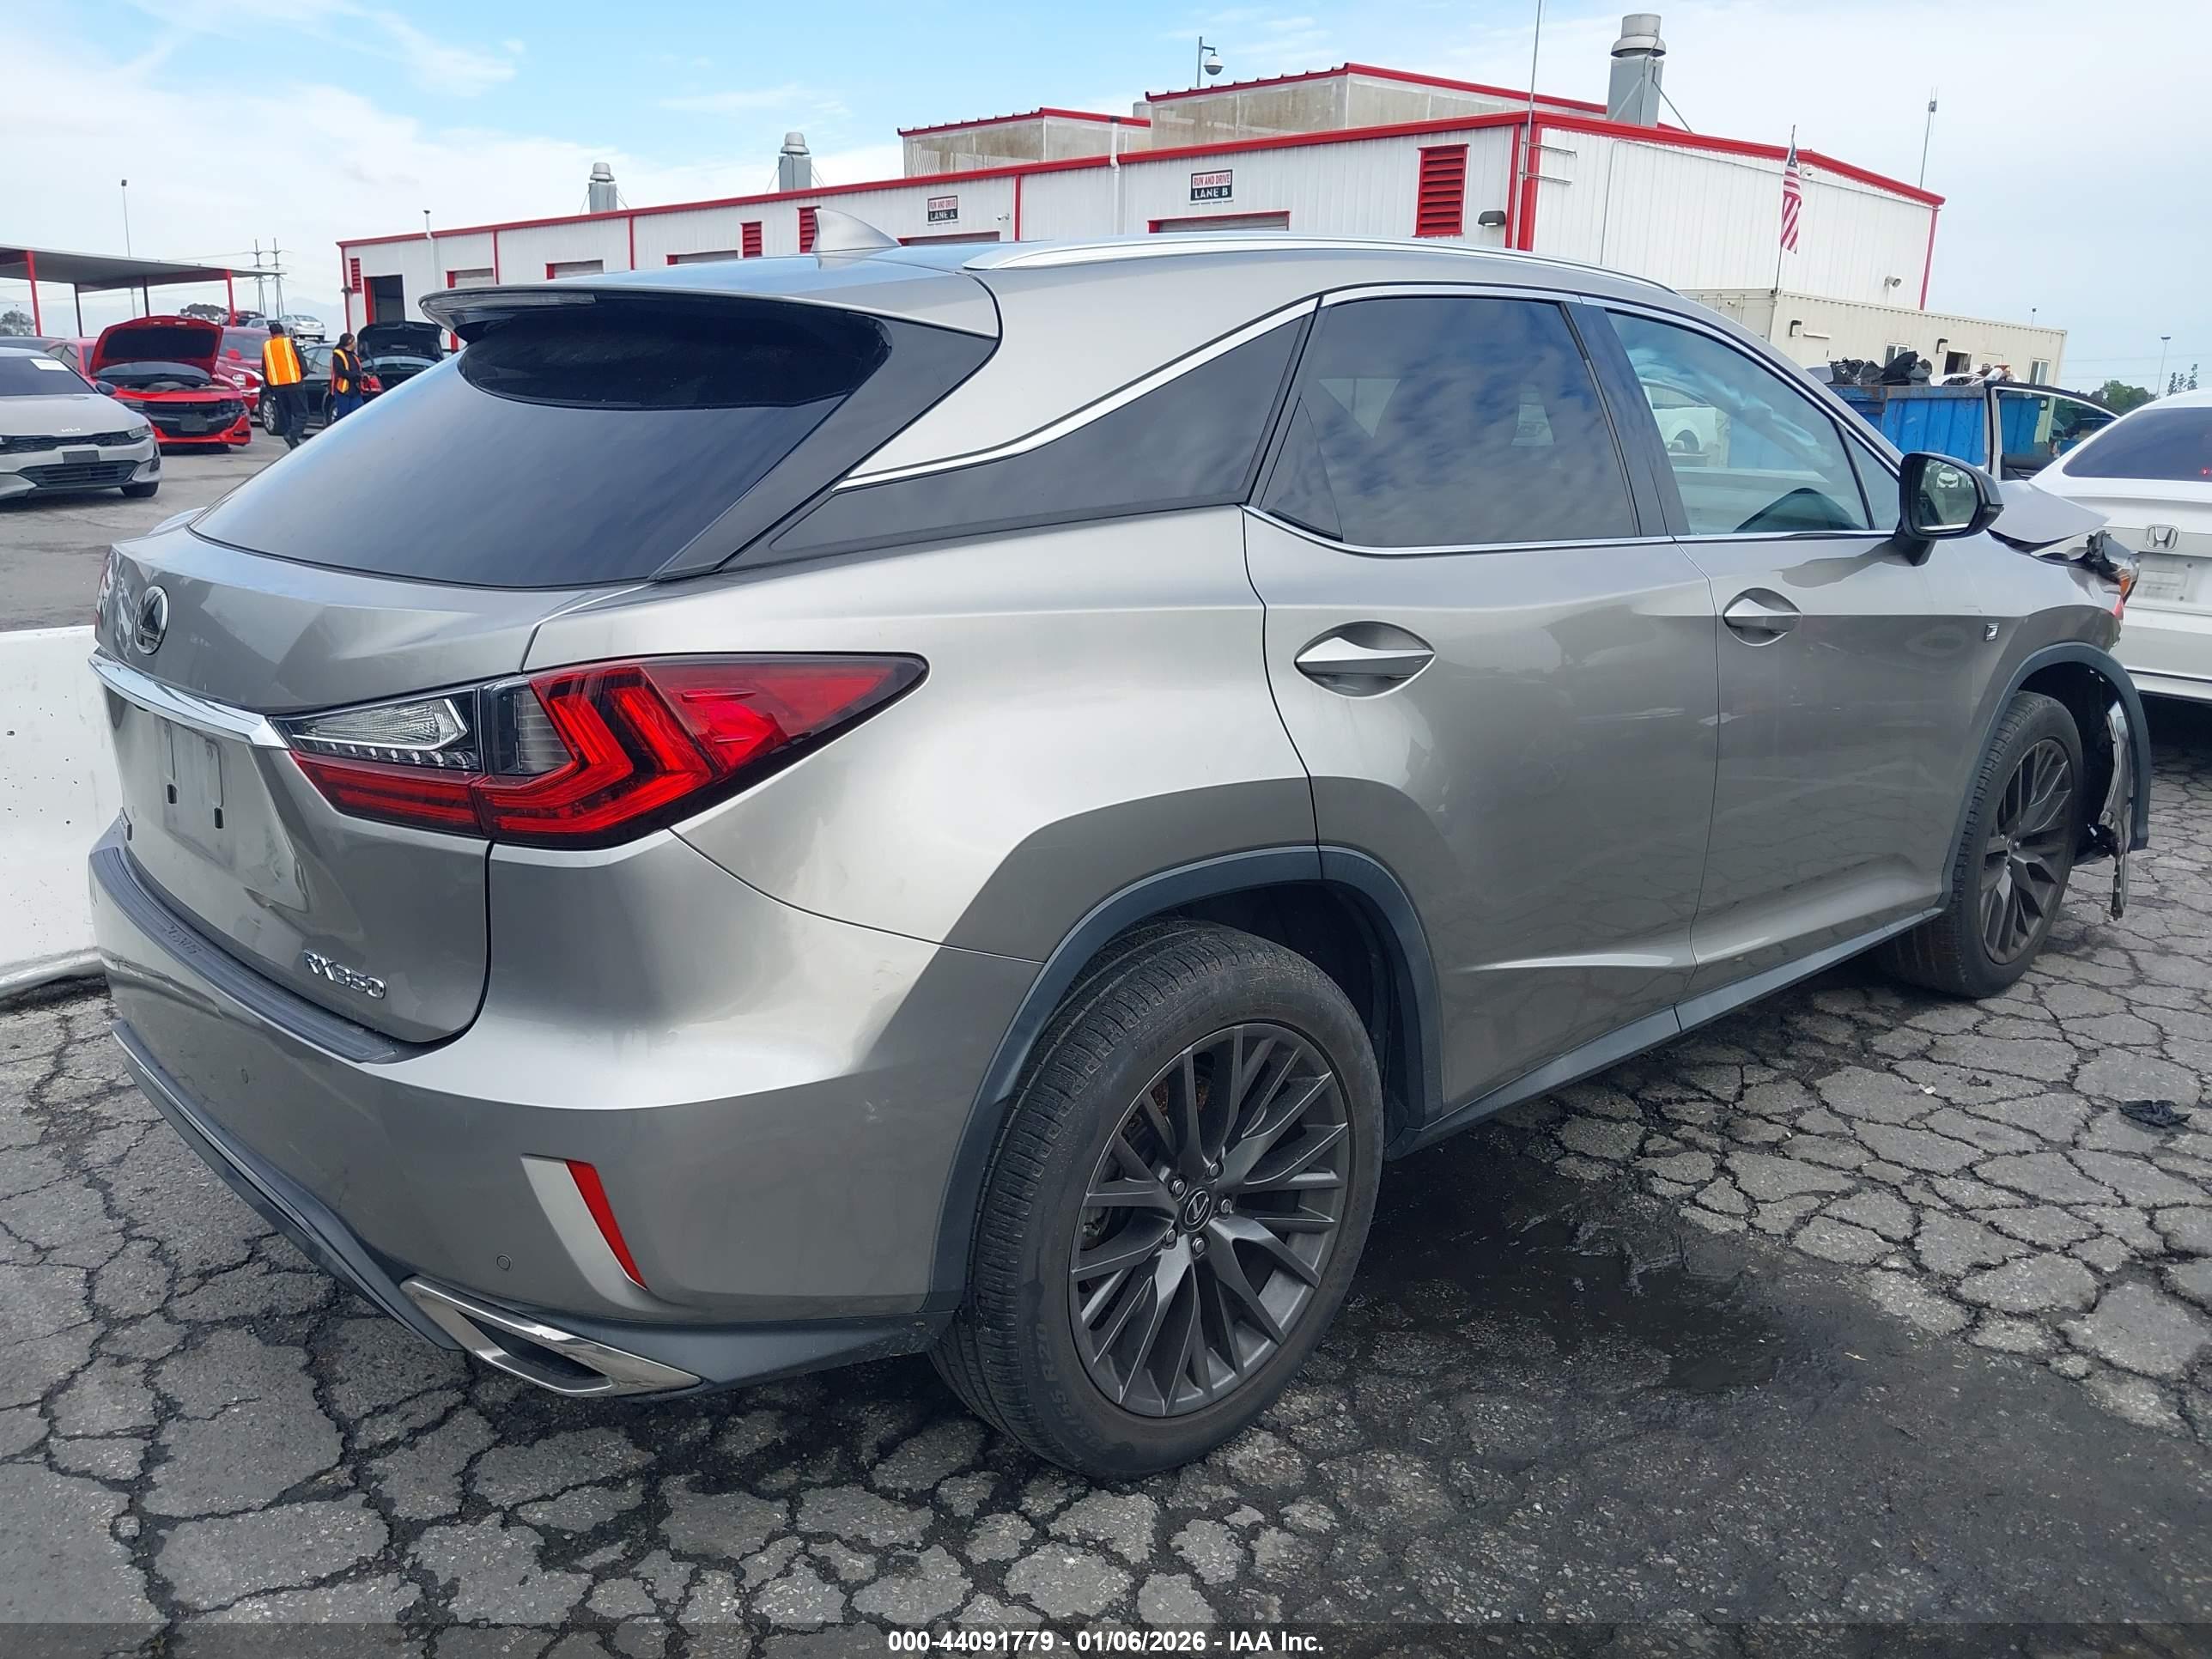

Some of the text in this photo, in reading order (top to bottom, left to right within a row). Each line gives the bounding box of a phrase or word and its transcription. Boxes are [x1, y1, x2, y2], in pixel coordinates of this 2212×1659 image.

[1193, 173, 1231, 186] RUN AND DRIVE
[1194, 187, 1229, 198] LANE B
[930, 211, 949, 221] LANE
[303, 948, 386, 1000] RX350
